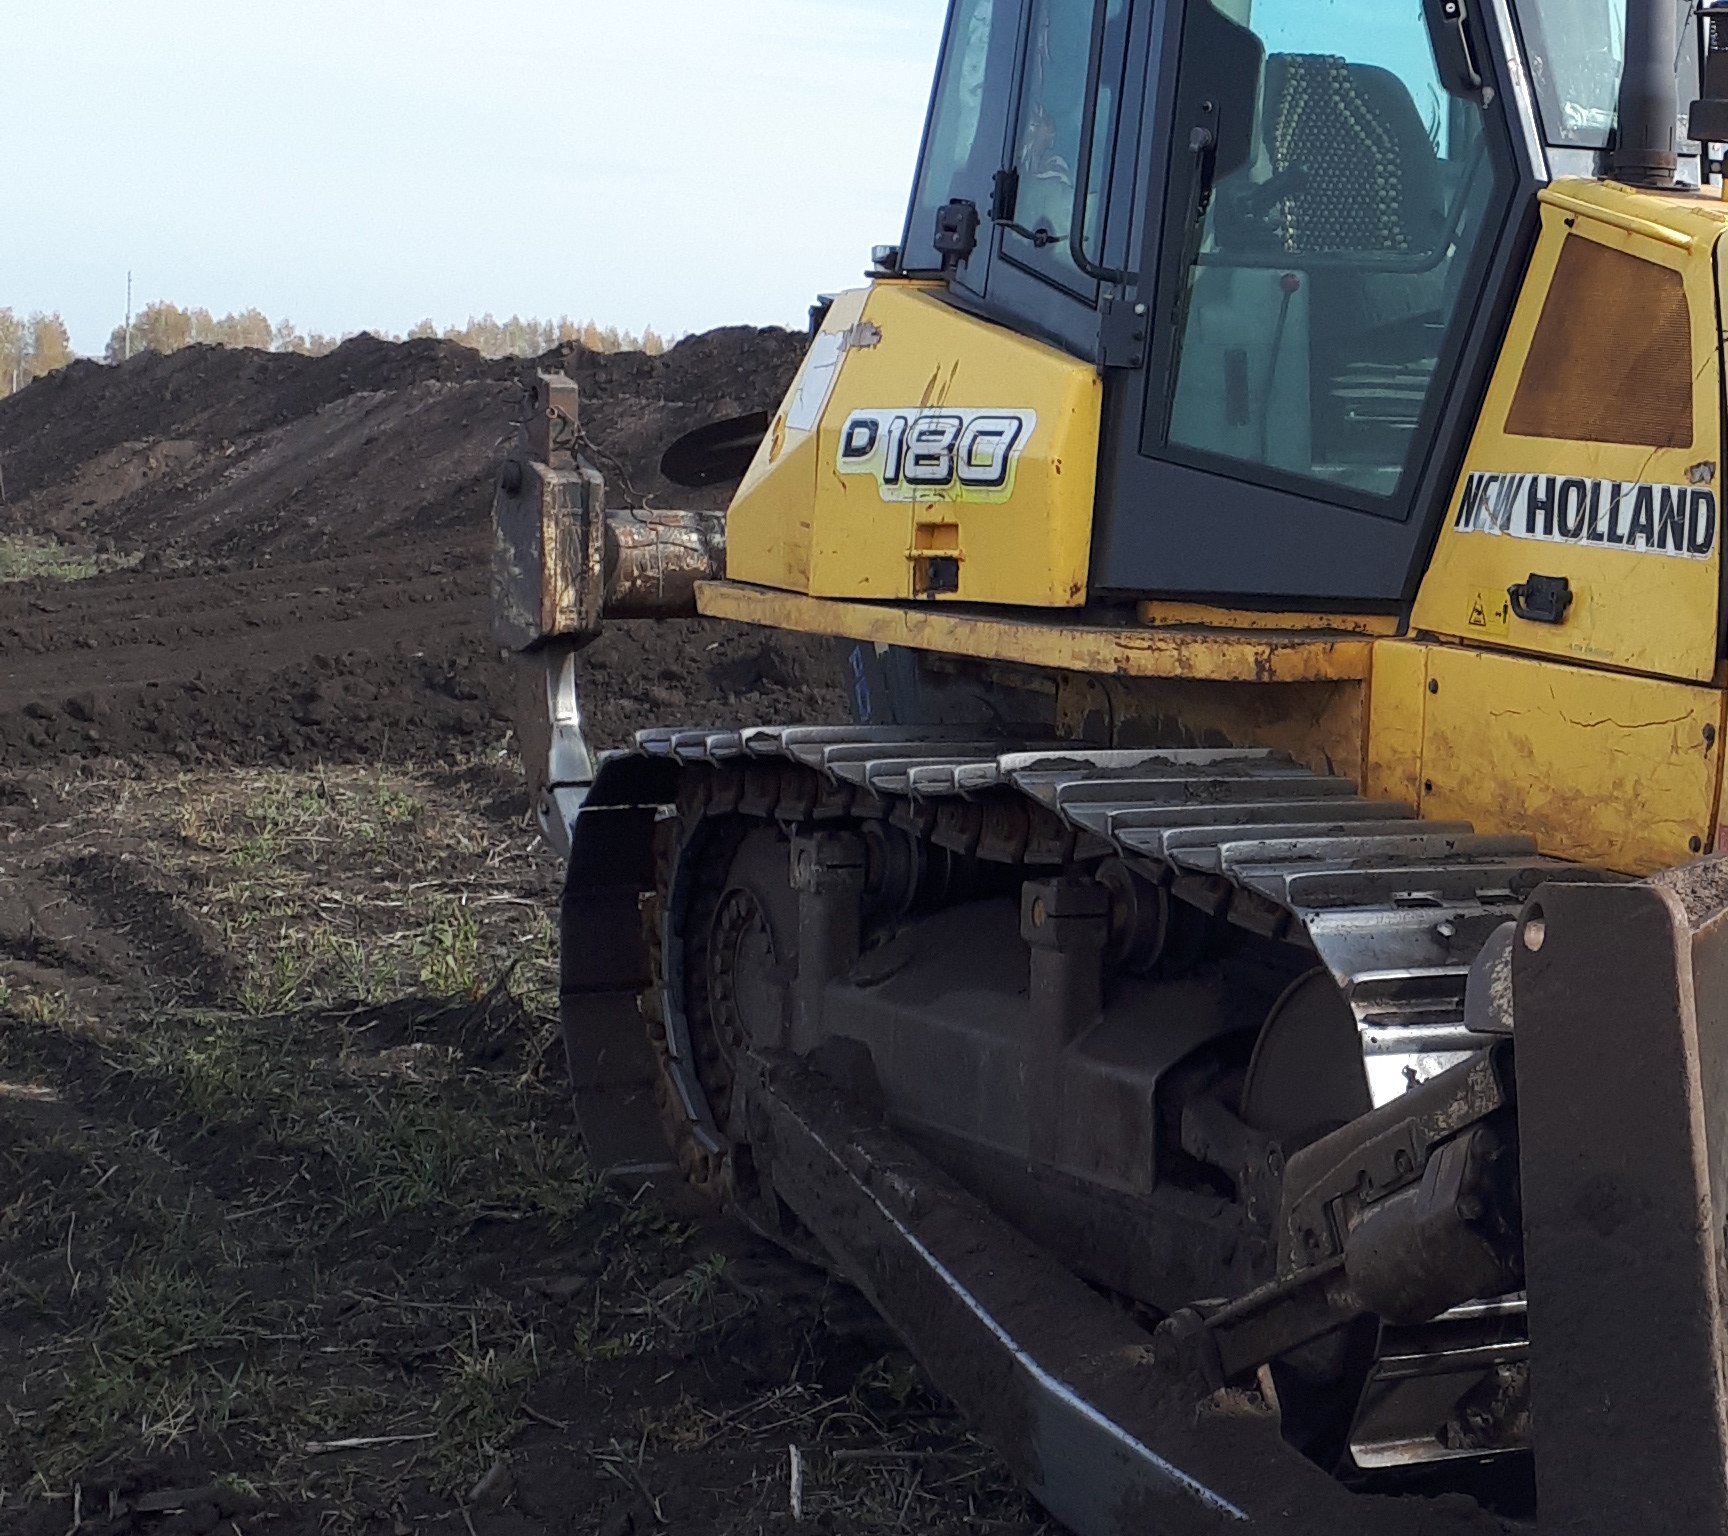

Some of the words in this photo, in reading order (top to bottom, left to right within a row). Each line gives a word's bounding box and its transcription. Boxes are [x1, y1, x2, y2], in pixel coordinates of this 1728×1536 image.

[842, 415, 1023, 487] D180
[1453, 472, 1526, 532] NEW
[1525, 474, 1717, 555] HOLLAND
